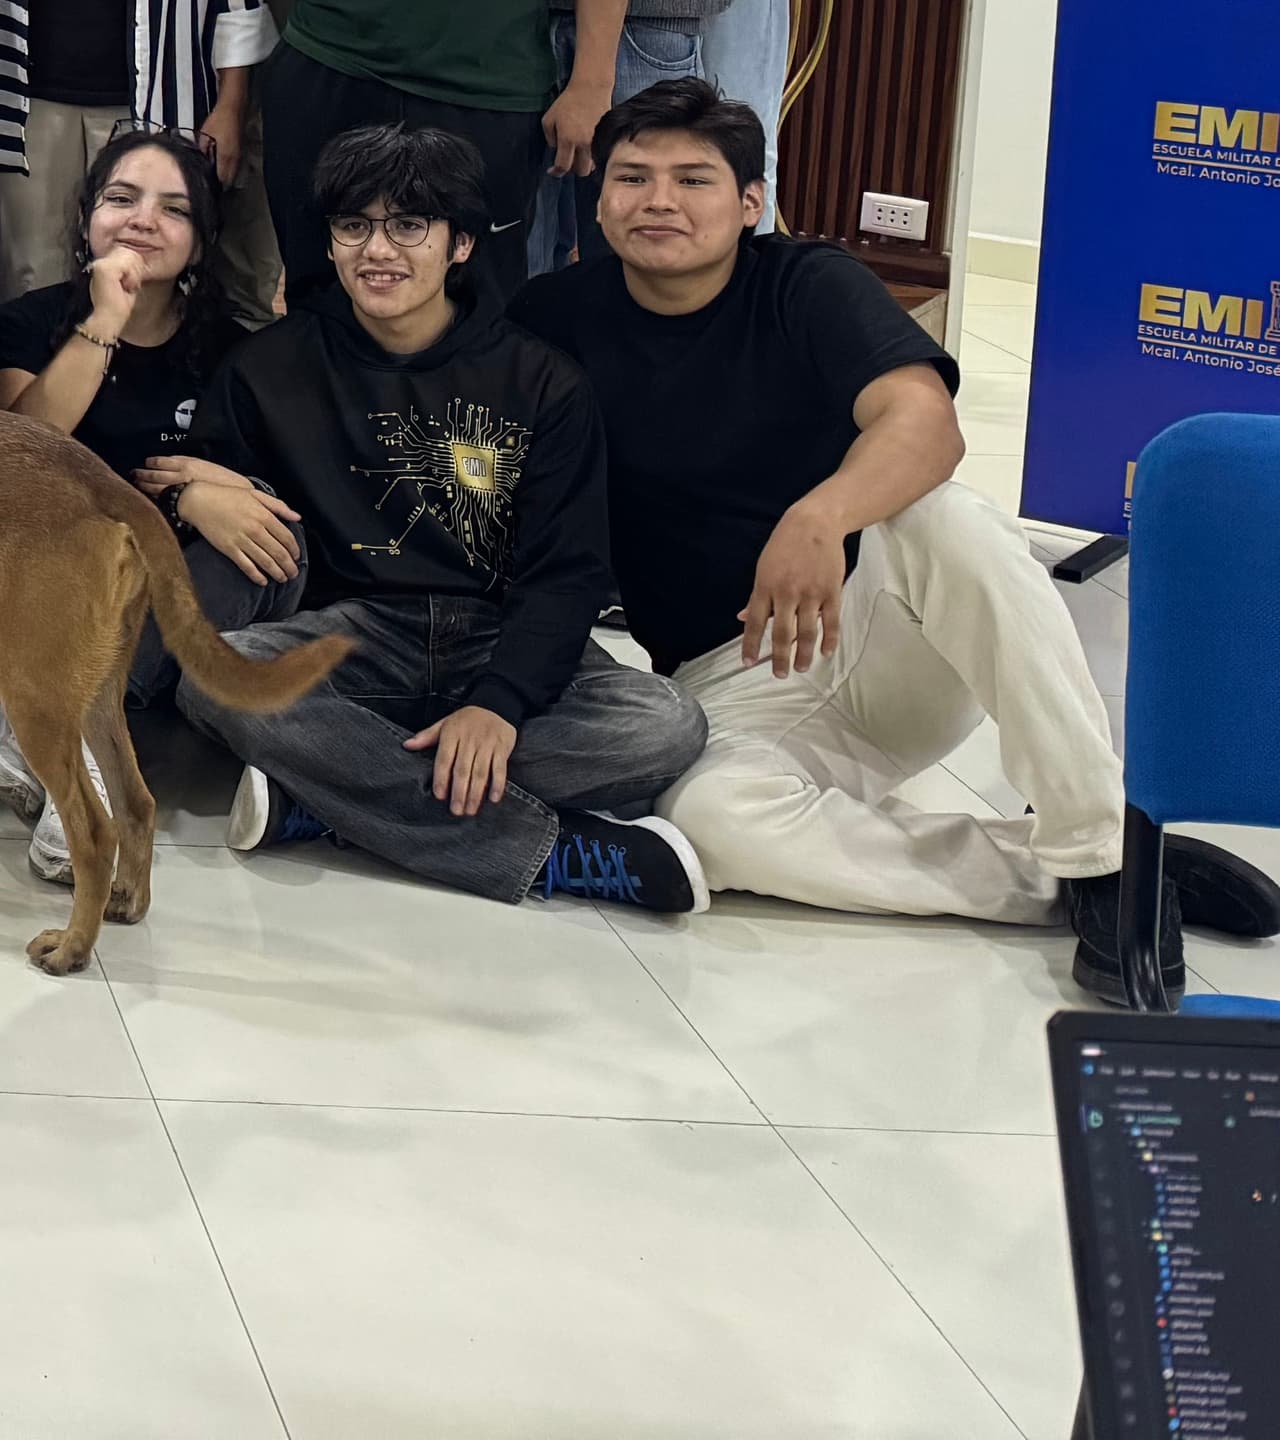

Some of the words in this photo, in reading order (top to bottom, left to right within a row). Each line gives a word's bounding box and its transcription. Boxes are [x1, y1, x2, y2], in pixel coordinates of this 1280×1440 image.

[1153, 101, 1280, 153] EMI
[1152, 143, 1213, 160] ESCUELA
[1216, 151, 1271, 166] MILITAR
[1157, 161, 1196, 177] Mcal.
[1199, 167, 1260, 185] Antonio
[1139, 283, 1264, 339] EMI
[1137, 324, 1197, 343] ESCUELA
[1200, 334, 1254, 352] MILITAR
[1258, 343, 1278, 356] DE
[1141, 343, 1180, 361] Mcal.
[1183, 350, 1244, 371] Antonio
